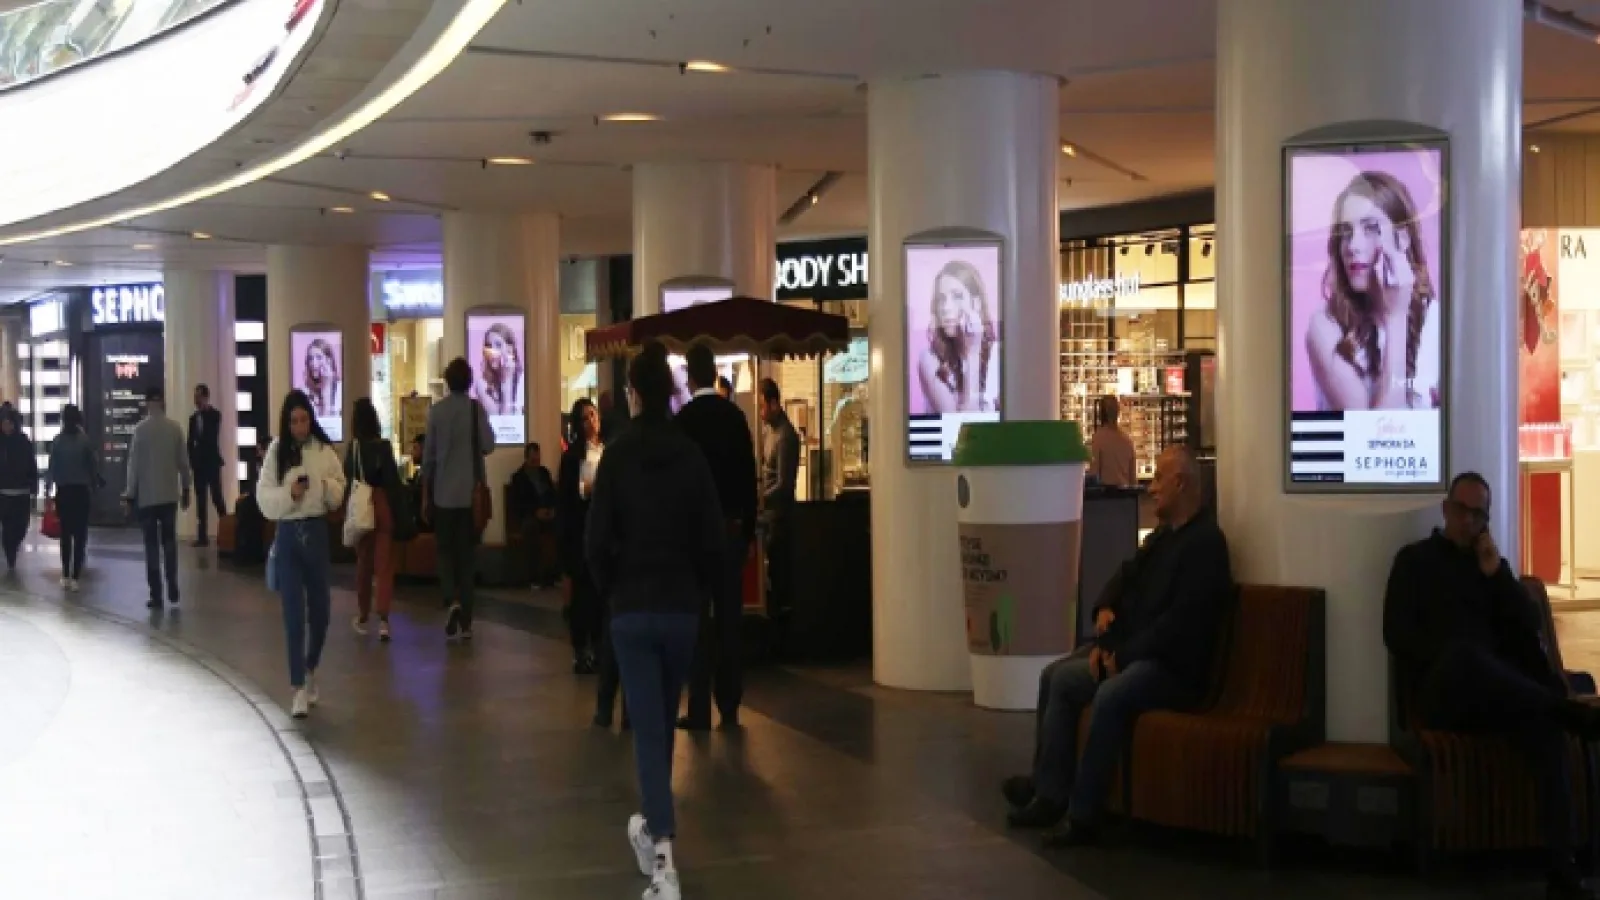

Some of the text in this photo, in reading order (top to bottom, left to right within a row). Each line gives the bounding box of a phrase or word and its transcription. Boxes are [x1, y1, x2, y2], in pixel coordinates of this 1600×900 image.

[837, 252, 869, 287] SH
[92, 283, 164, 324] SEPHO
[1354, 456, 1428, 470] SEPHORA
